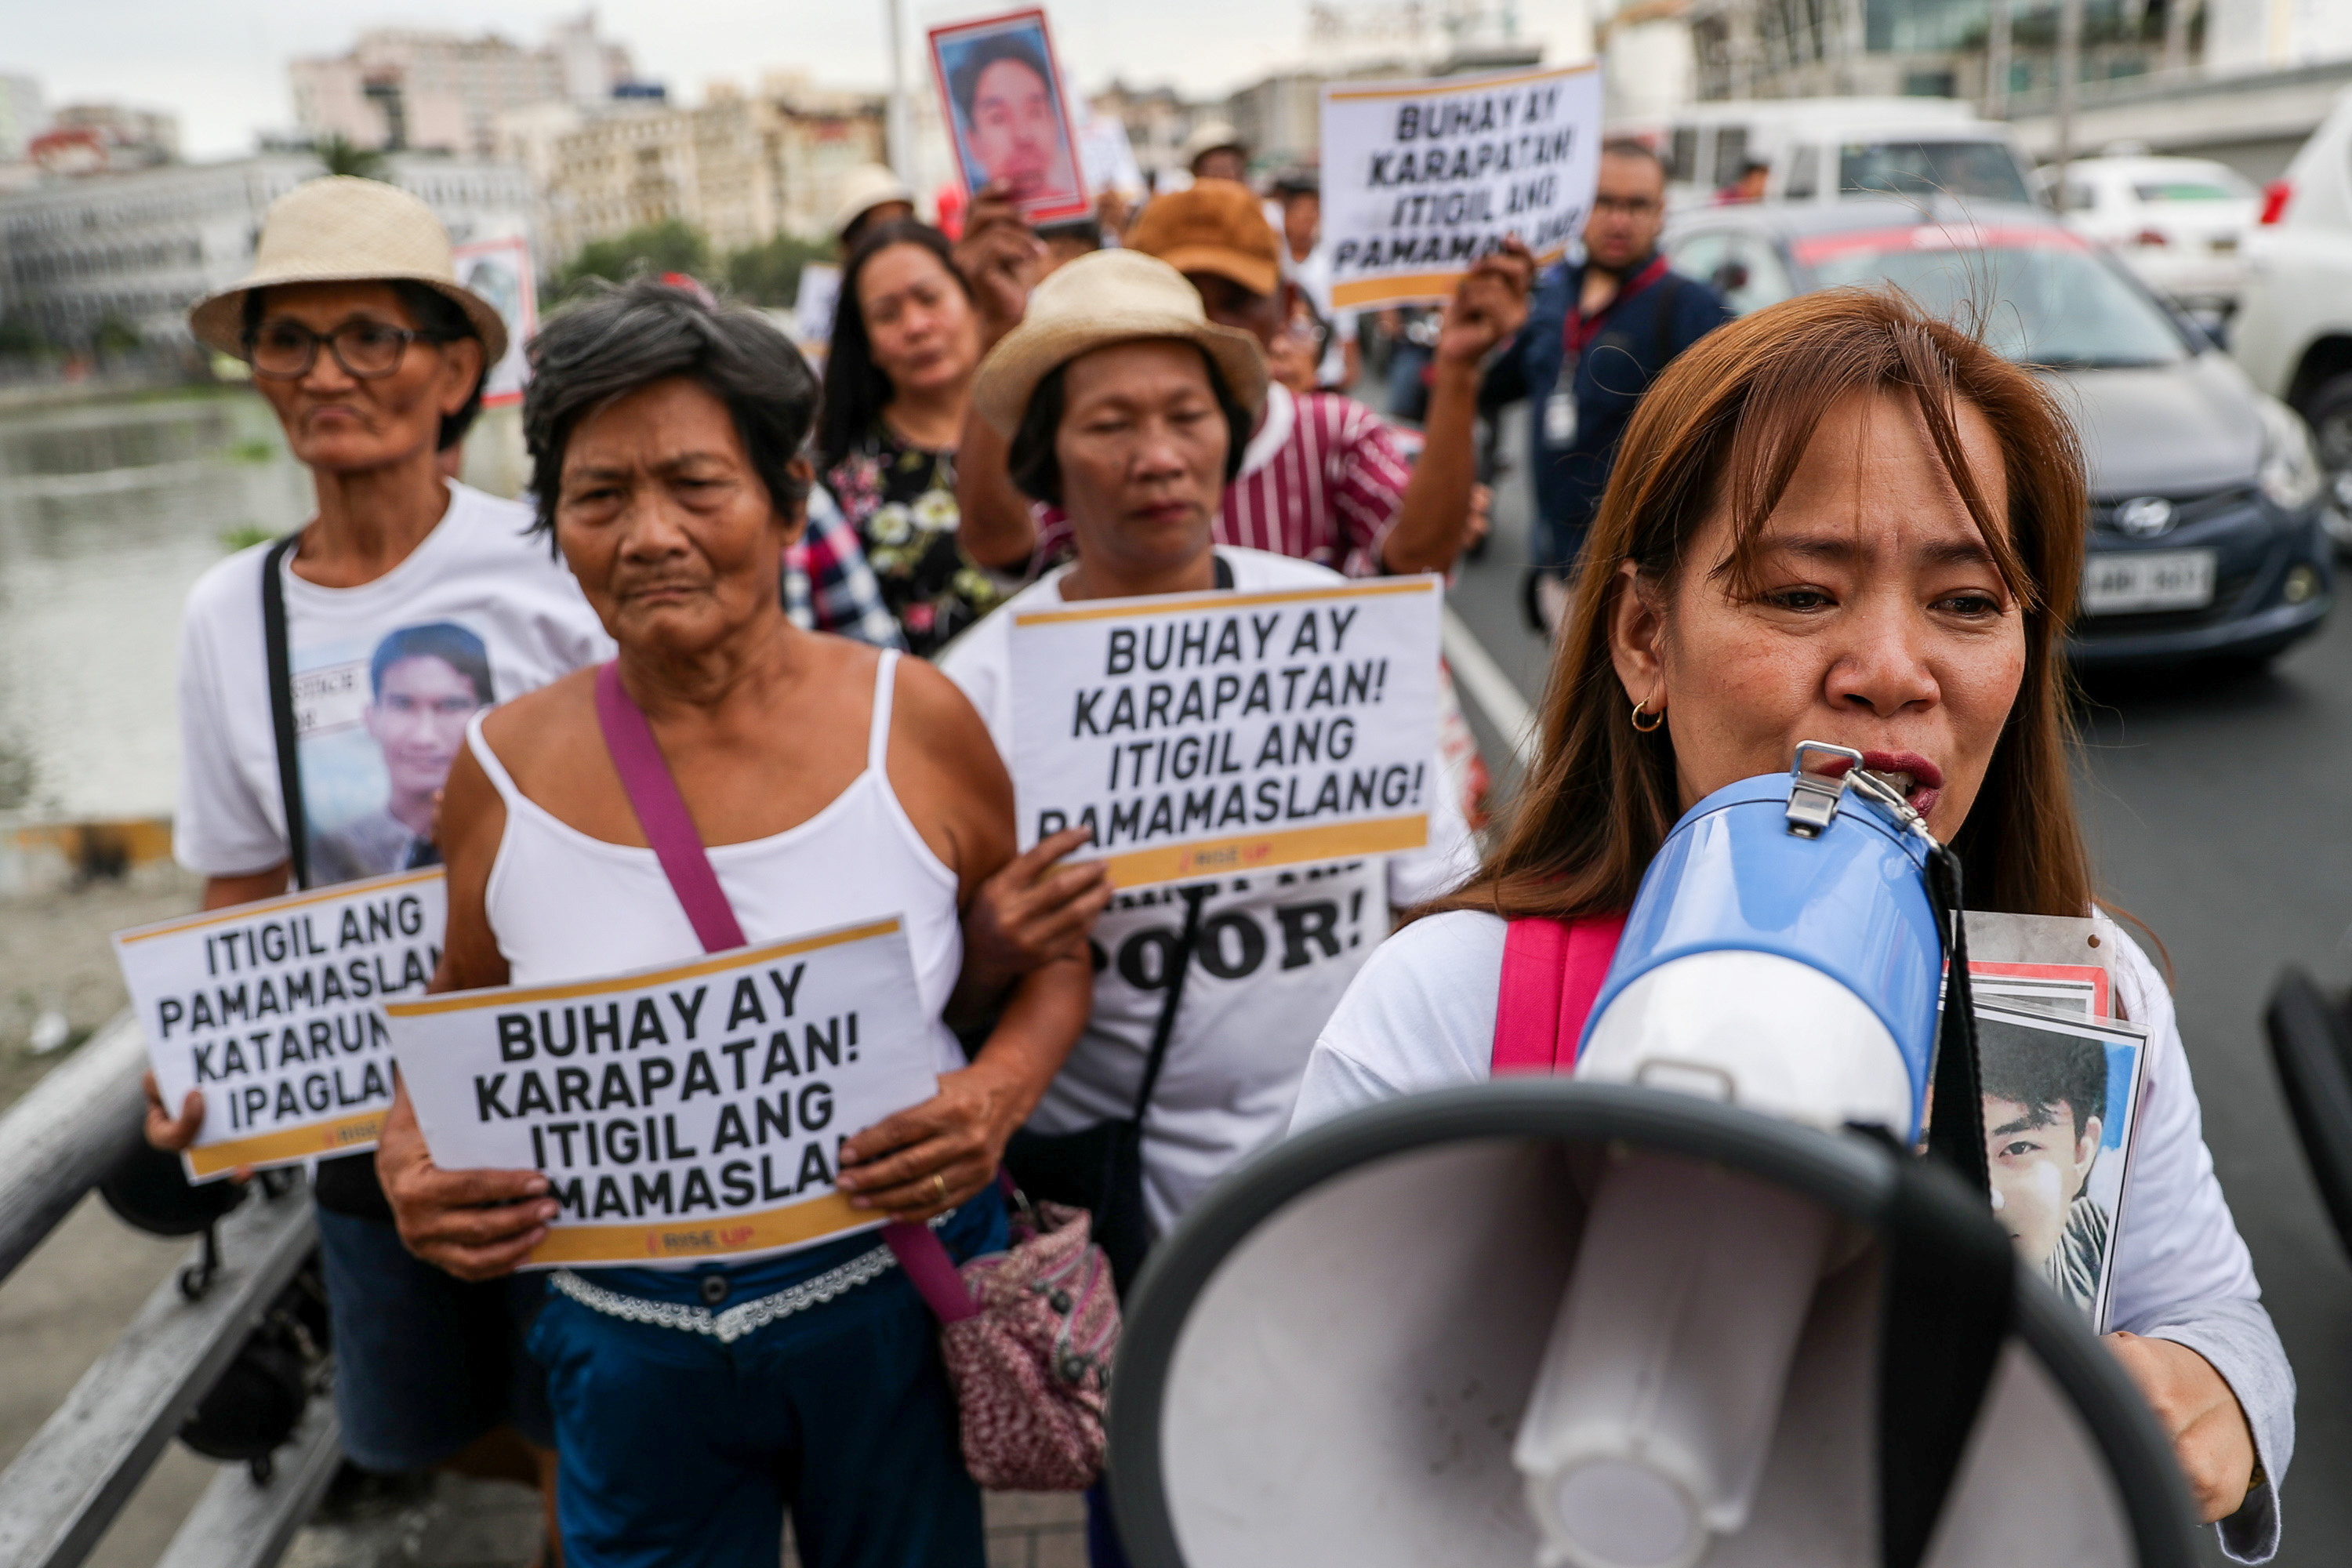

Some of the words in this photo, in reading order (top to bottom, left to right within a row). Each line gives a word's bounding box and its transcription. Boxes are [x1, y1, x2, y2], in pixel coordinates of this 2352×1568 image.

[1396, 94, 1519, 143] BUHAY
[1523, 85, 1563, 124] AY
[1391, 187, 1494, 228] ITIGIL
[1106, 612, 1281, 676] BUHAY
[1289, 606, 1359, 659] AY
[1071, 658, 1389, 739] KARAPATAN!
[1108, 730, 1242, 792] ITIGIL
[1256, 717, 1356, 769] ANG
[204, 913, 326, 976] ITIGIL
[339, 892, 423, 950] ANG
[1088, 887, 1365, 992] OOR!
[495, 985, 709, 1064] BUHAY
[725, 961, 808, 1032] AY
[229, 1054, 397, 1133] IPAGLA
[473, 1011, 861, 1123] KARAPATAN!
[531, 1113, 696, 1170] ITIGIL
[711, 1081, 836, 1156] ANG
[547, 1134, 847, 1221] MAMASLA
